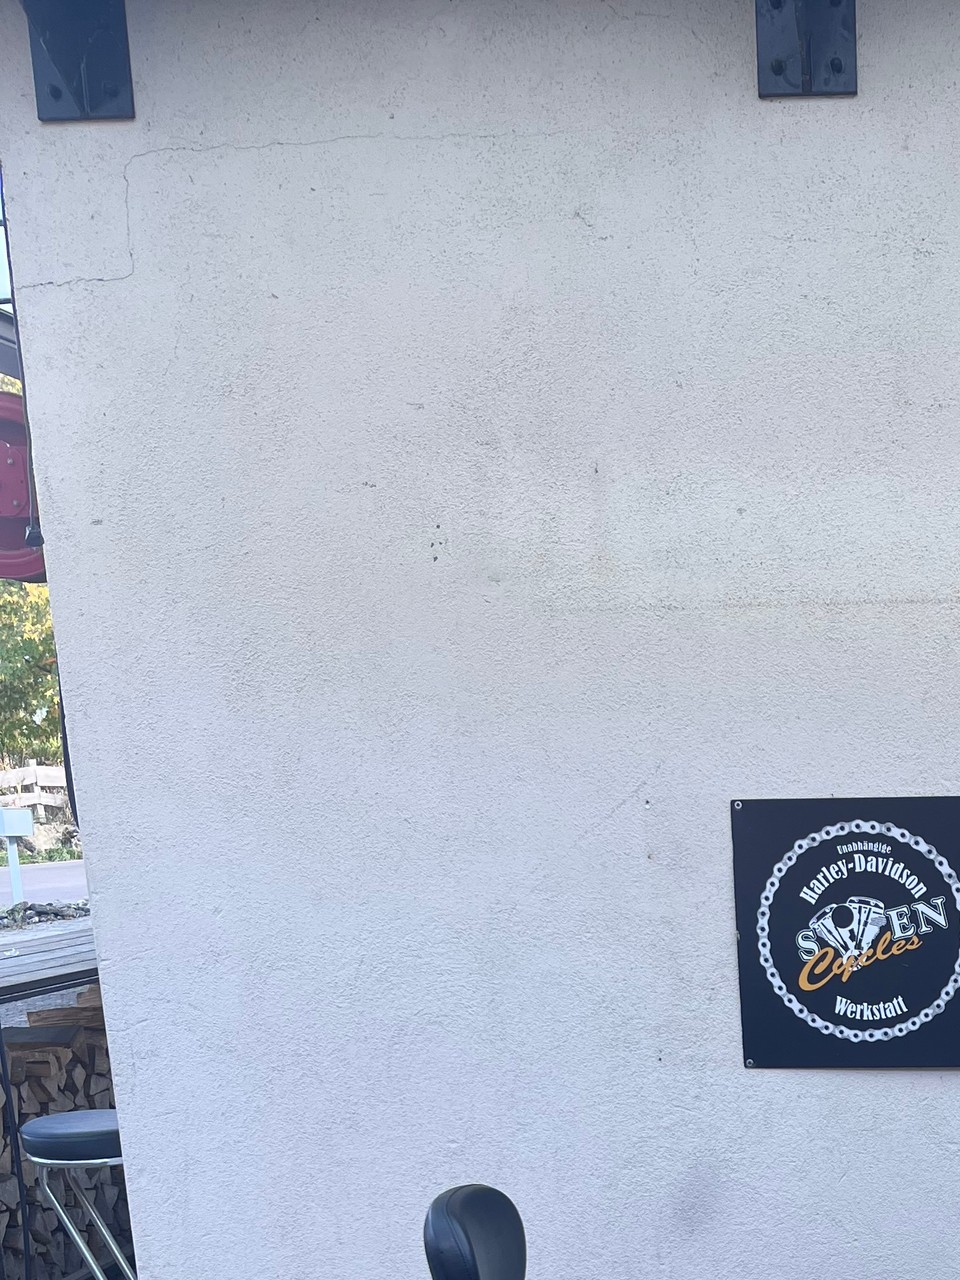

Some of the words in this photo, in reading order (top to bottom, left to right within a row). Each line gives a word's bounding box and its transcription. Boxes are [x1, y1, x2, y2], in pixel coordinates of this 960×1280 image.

[836, 840, 892, 855] Unabhängige
[799, 853, 928, 905] Harley-Davidson
[798, 930, 923, 992] Cycles
[834, 995, 909, 1020] Werkstatt
